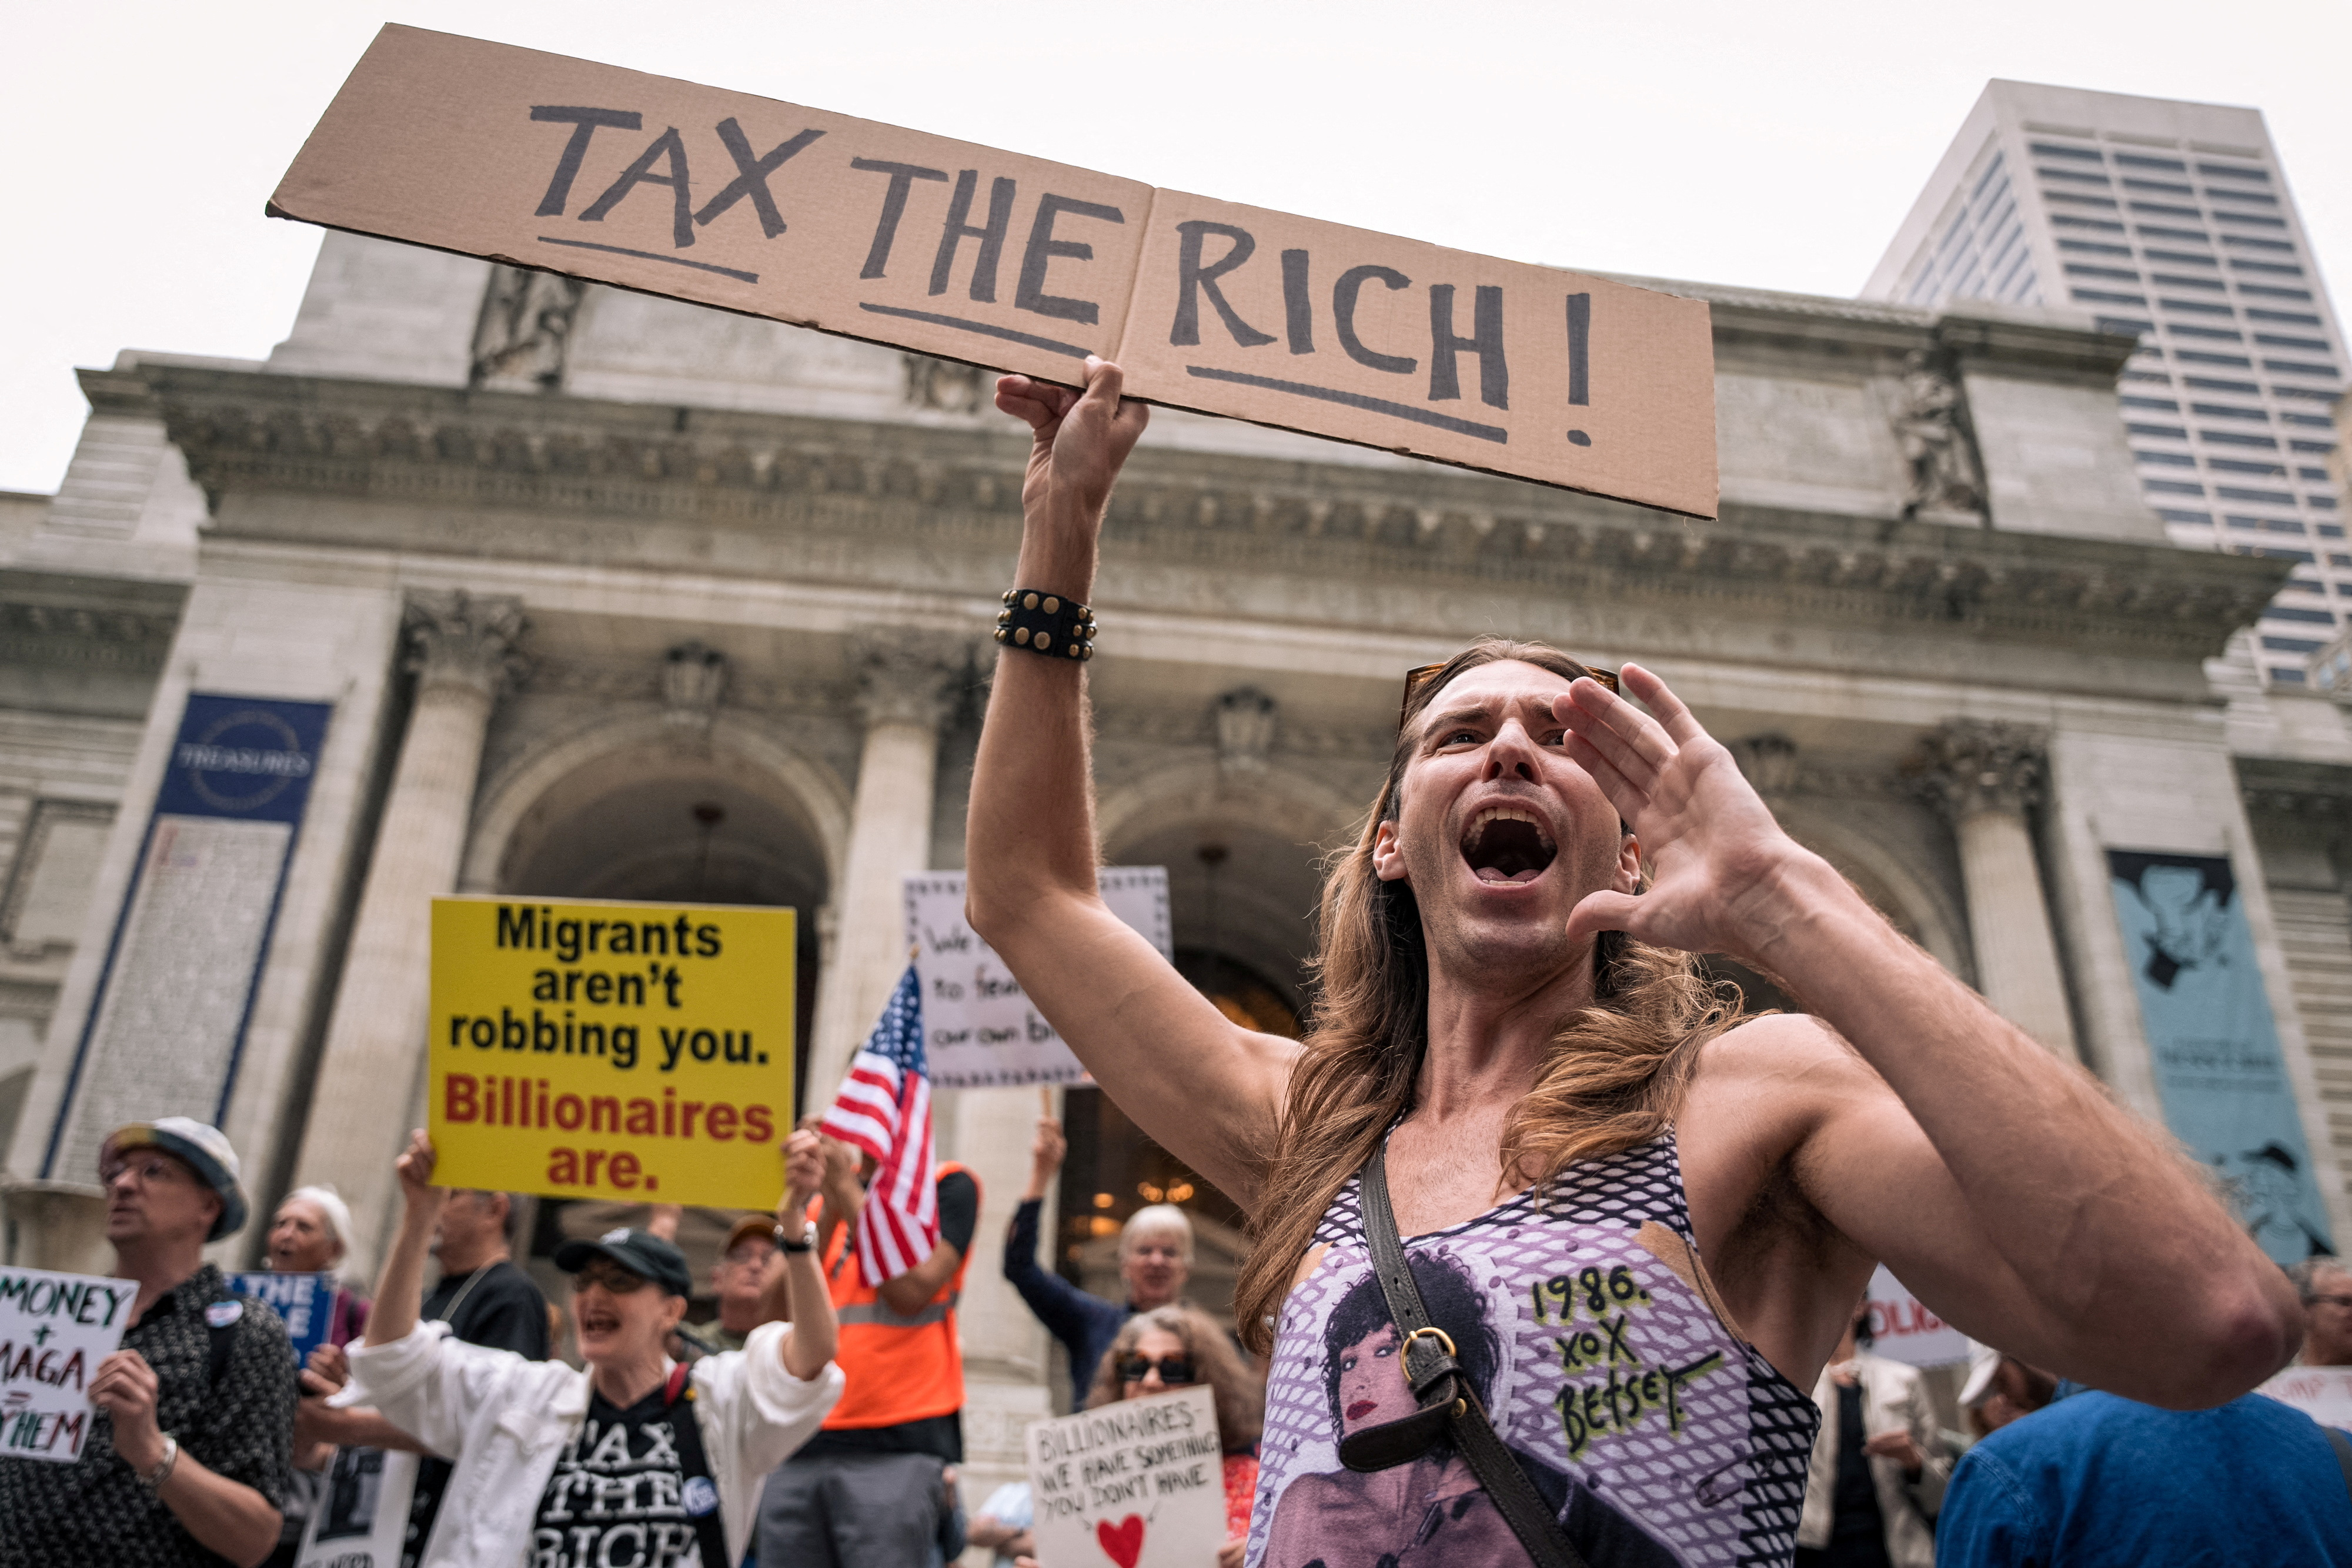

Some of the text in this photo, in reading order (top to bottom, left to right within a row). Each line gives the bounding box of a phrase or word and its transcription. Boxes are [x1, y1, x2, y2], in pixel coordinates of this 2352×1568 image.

[530, 106, 828, 249] TAX
[850, 156, 1125, 325] THE
[496, 905, 723, 963] Migrants
[532, 962, 682, 1009] aren't
[450, 1006, 769, 1072] robbing you.
[445, 1072, 775, 1143] Billionaires
[547, 1147, 659, 1192] are.
[0, 1276, 133, 1328] MONEY
[242, 1272, 318, 1306] THE
[1532, 1265, 1647, 1319] 1986.
[1040, 1490, 1085, 1524] YOU
[1154, 1462, 1210, 1496] HAVE
[1080, 1447, 1133, 1486] HAVE
[542, 1469, 688, 1523] THE
